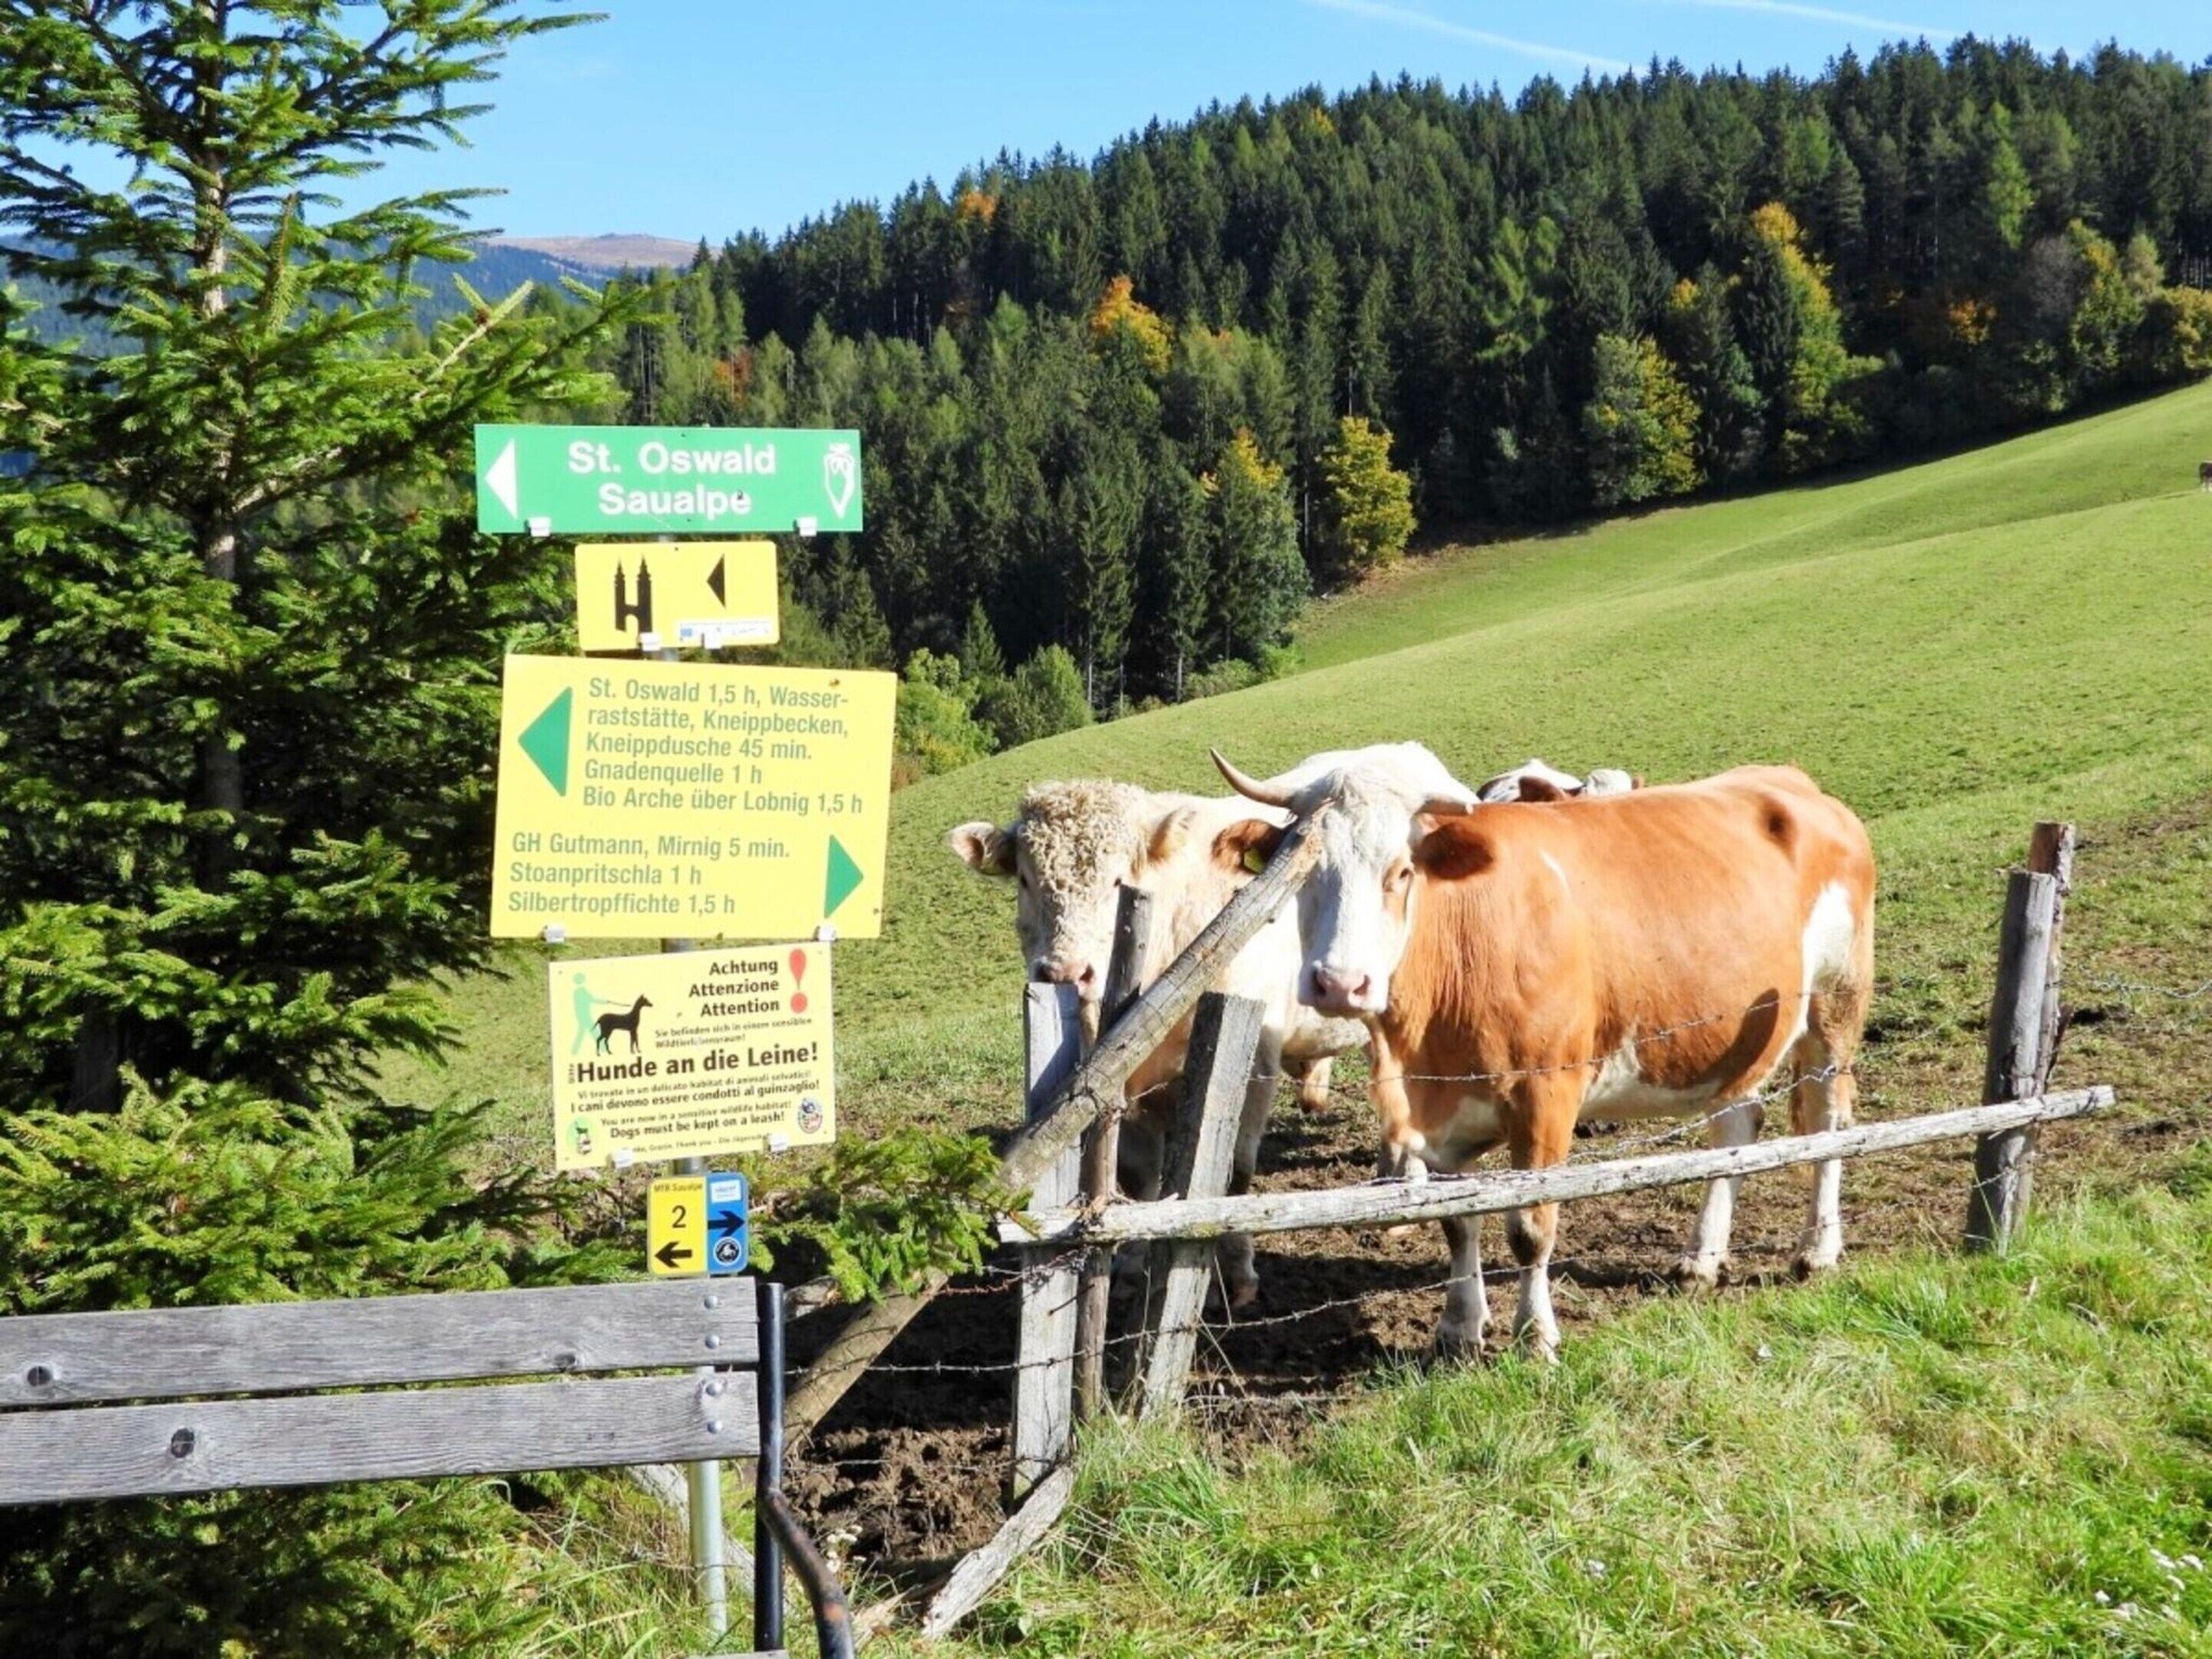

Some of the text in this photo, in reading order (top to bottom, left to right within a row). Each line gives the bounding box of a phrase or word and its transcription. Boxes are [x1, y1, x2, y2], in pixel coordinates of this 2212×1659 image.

[568, 441, 776, 475] St. Oswald
[598, 484, 752, 520] Saualpe
[589, 677, 848, 709] St. Oswald 1,5 h, Wasser-
[588, 707, 848, 737] raststätte, Kneippbecken,
[587, 732, 812, 760] Kneippdusche 45 min.
[584, 759, 762, 784] Gnadenquelle 1 h
[583, 786, 863, 816] Bio Arche über Lobnig 1,5 h
[512, 832, 790, 861] GH Gutmann, Mirnig 5 min.
[509, 861, 701, 888] Stoanpritschla 1 h
[508, 892, 735, 918] Silbertropffichte 1,5 h
[709, 959, 779, 976] Achtung
[688, 979, 779, 998] Attenzione
[700, 999, 780, 1018] Attention
[577, 1041, 819, 1083] Hunde an die Leine!
[578, 1100, 604, 1112] cani
[606, 1097, 650, 1111] devono
[651, 1093, 690, 1105] essere
[692, 1087, 740, 1101] condotti
[757, 1079, 820, 1098] guinzaglio!
[611, 1127, 641, 1140] Dogs
[644, 1122, 673, 1135] must
[676, 1120, 690, 1131] be
[694, 1118, 719, 1131] kept
[722, 1118, 737, 1128] on
[750, 1110, 785, 1124] leash!
[671, 1204, 687, 1229] 2
